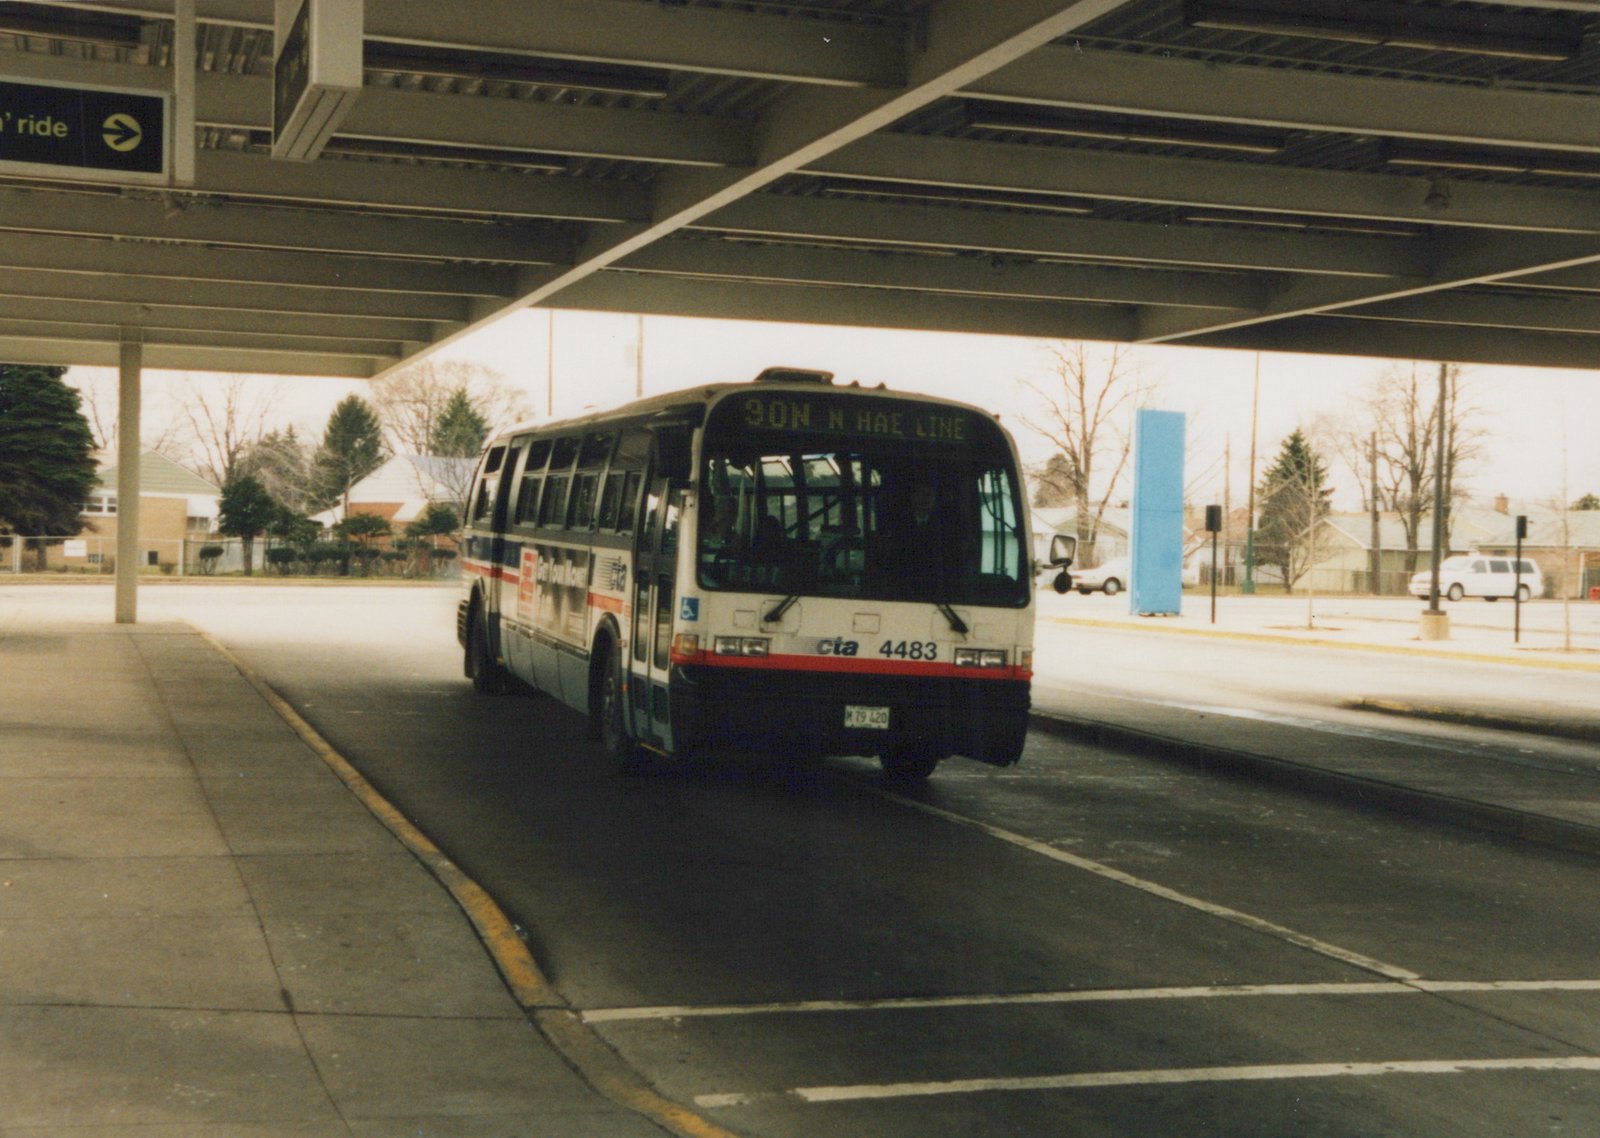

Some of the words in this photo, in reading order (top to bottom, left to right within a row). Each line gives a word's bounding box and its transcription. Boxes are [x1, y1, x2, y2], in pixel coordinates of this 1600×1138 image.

[18, 114, 68, 138] ride
[745, 400, 810, 429] 90N
[816, 636, 859, 656] cta
[879, 640, 937, 660] 4483
